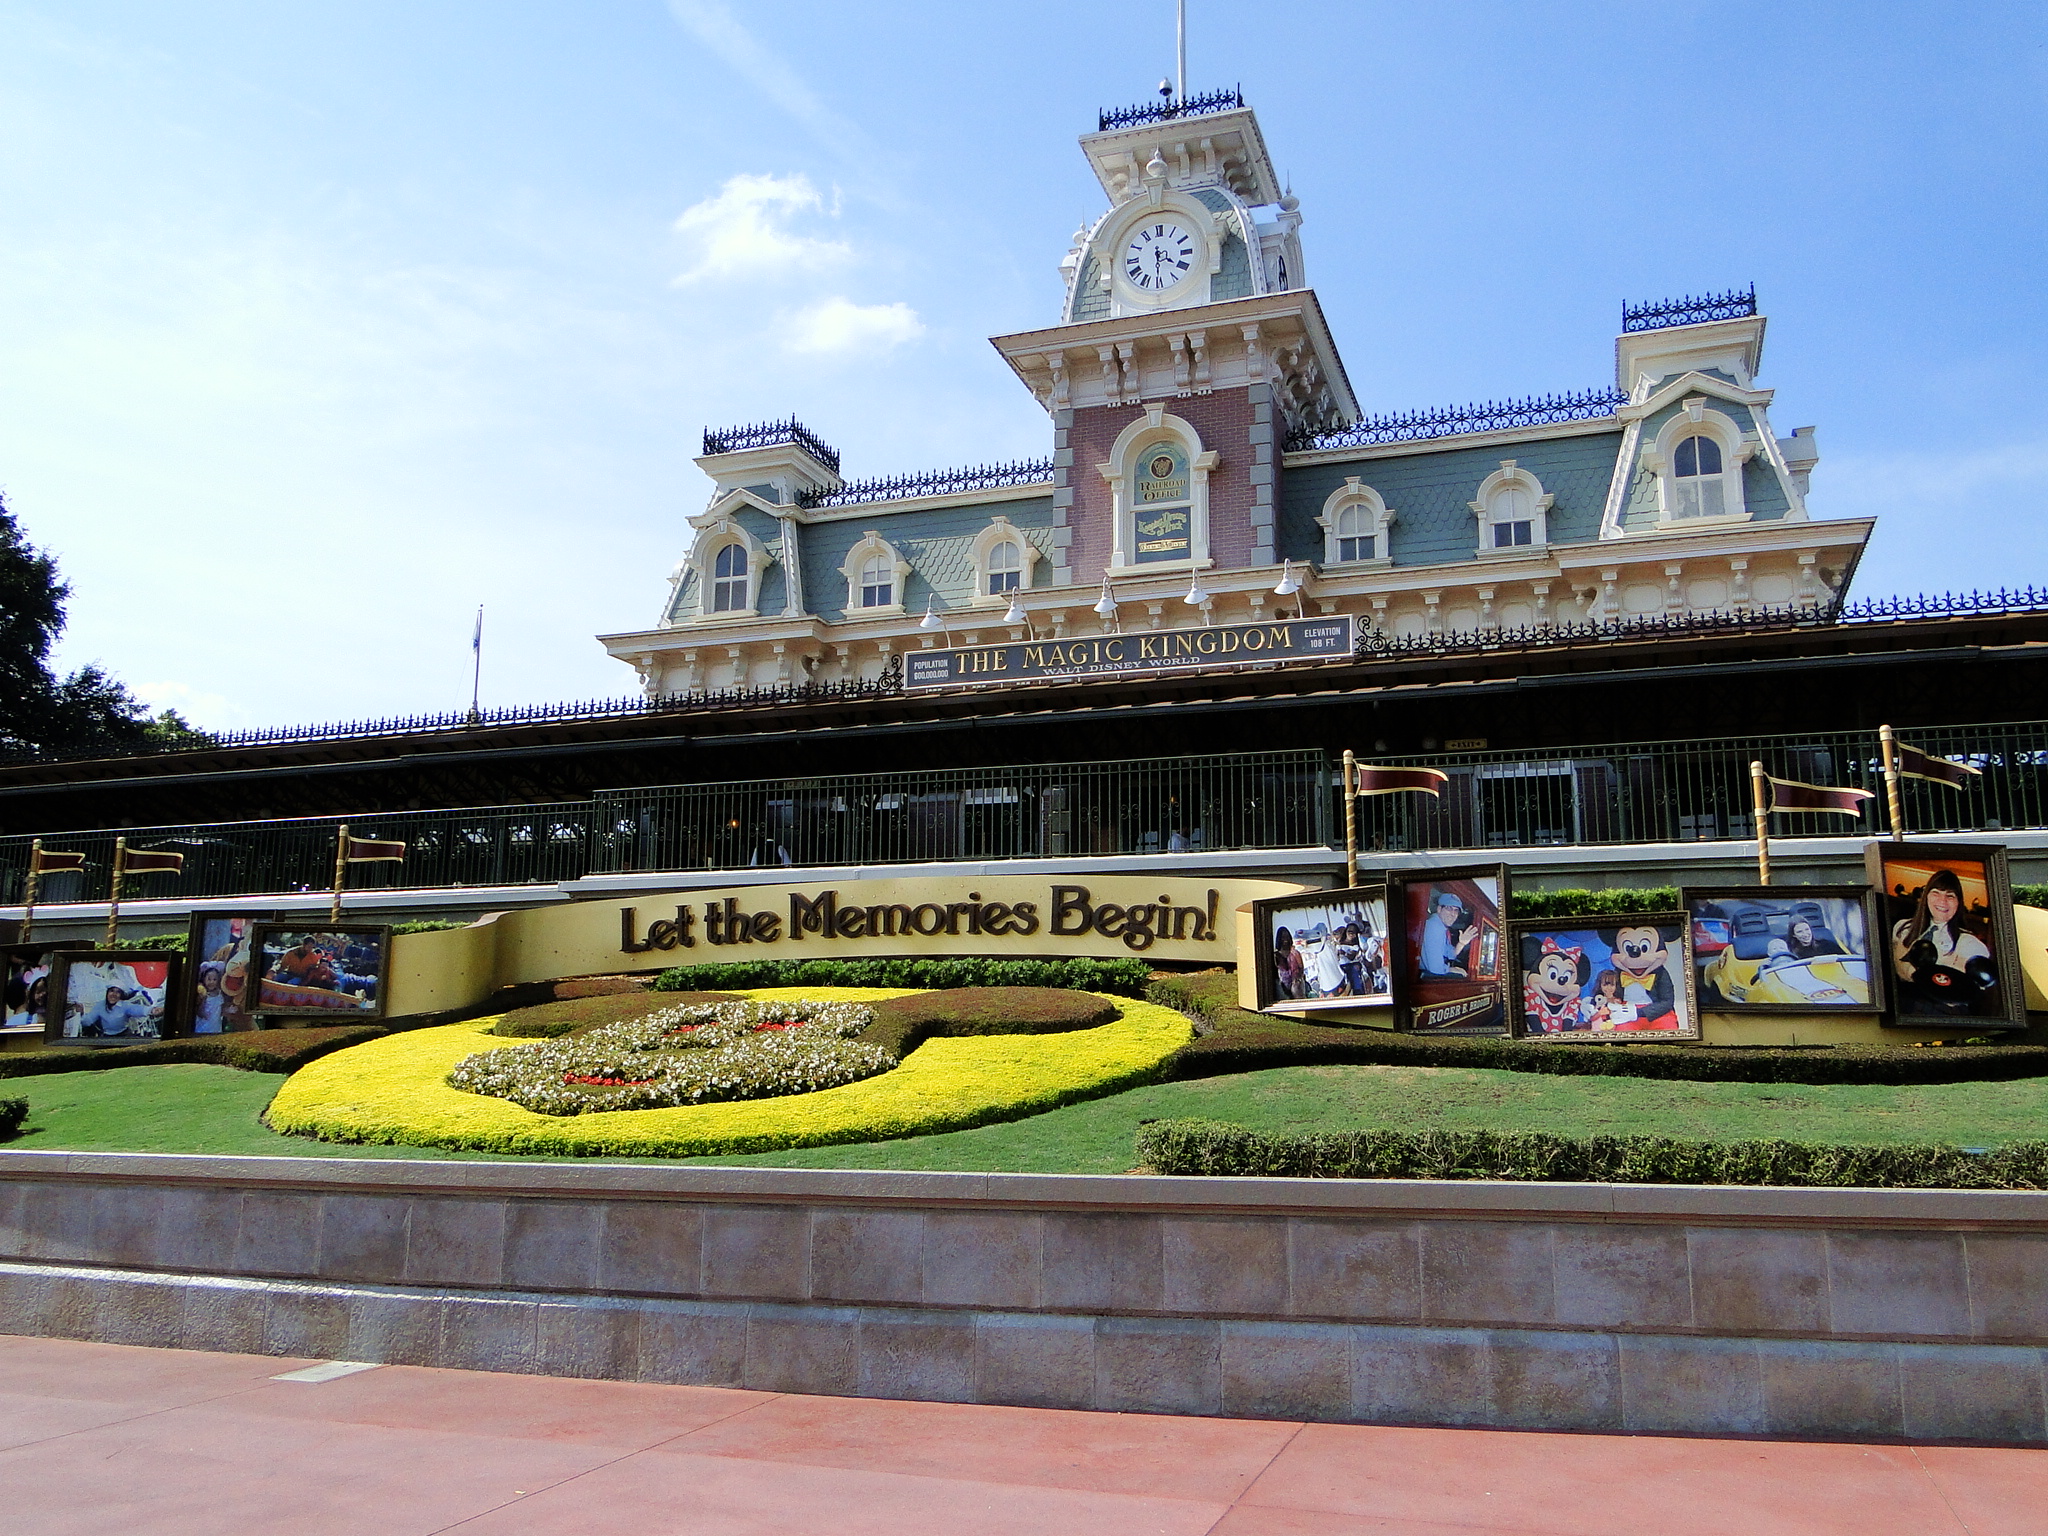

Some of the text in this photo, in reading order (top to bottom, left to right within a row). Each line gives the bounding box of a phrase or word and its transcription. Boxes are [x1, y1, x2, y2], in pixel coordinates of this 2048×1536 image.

[1143, 489, 1182, 501] OFFICE
[1304, 626, 1340, 638] ELEVATION
[955, 626, 1293, 674] THE MAGIC KINGDOM
[1310, 637, 1336, 648] 108 FT.
[914, 659, 949, 669] POPULATION
[1043, 656, 1201, 676] WALT DISNEY WORLD
[619, 885, 1219, 953] Let the Memories Begin!
[1427, 1005, 1461, 1025] ROGER
